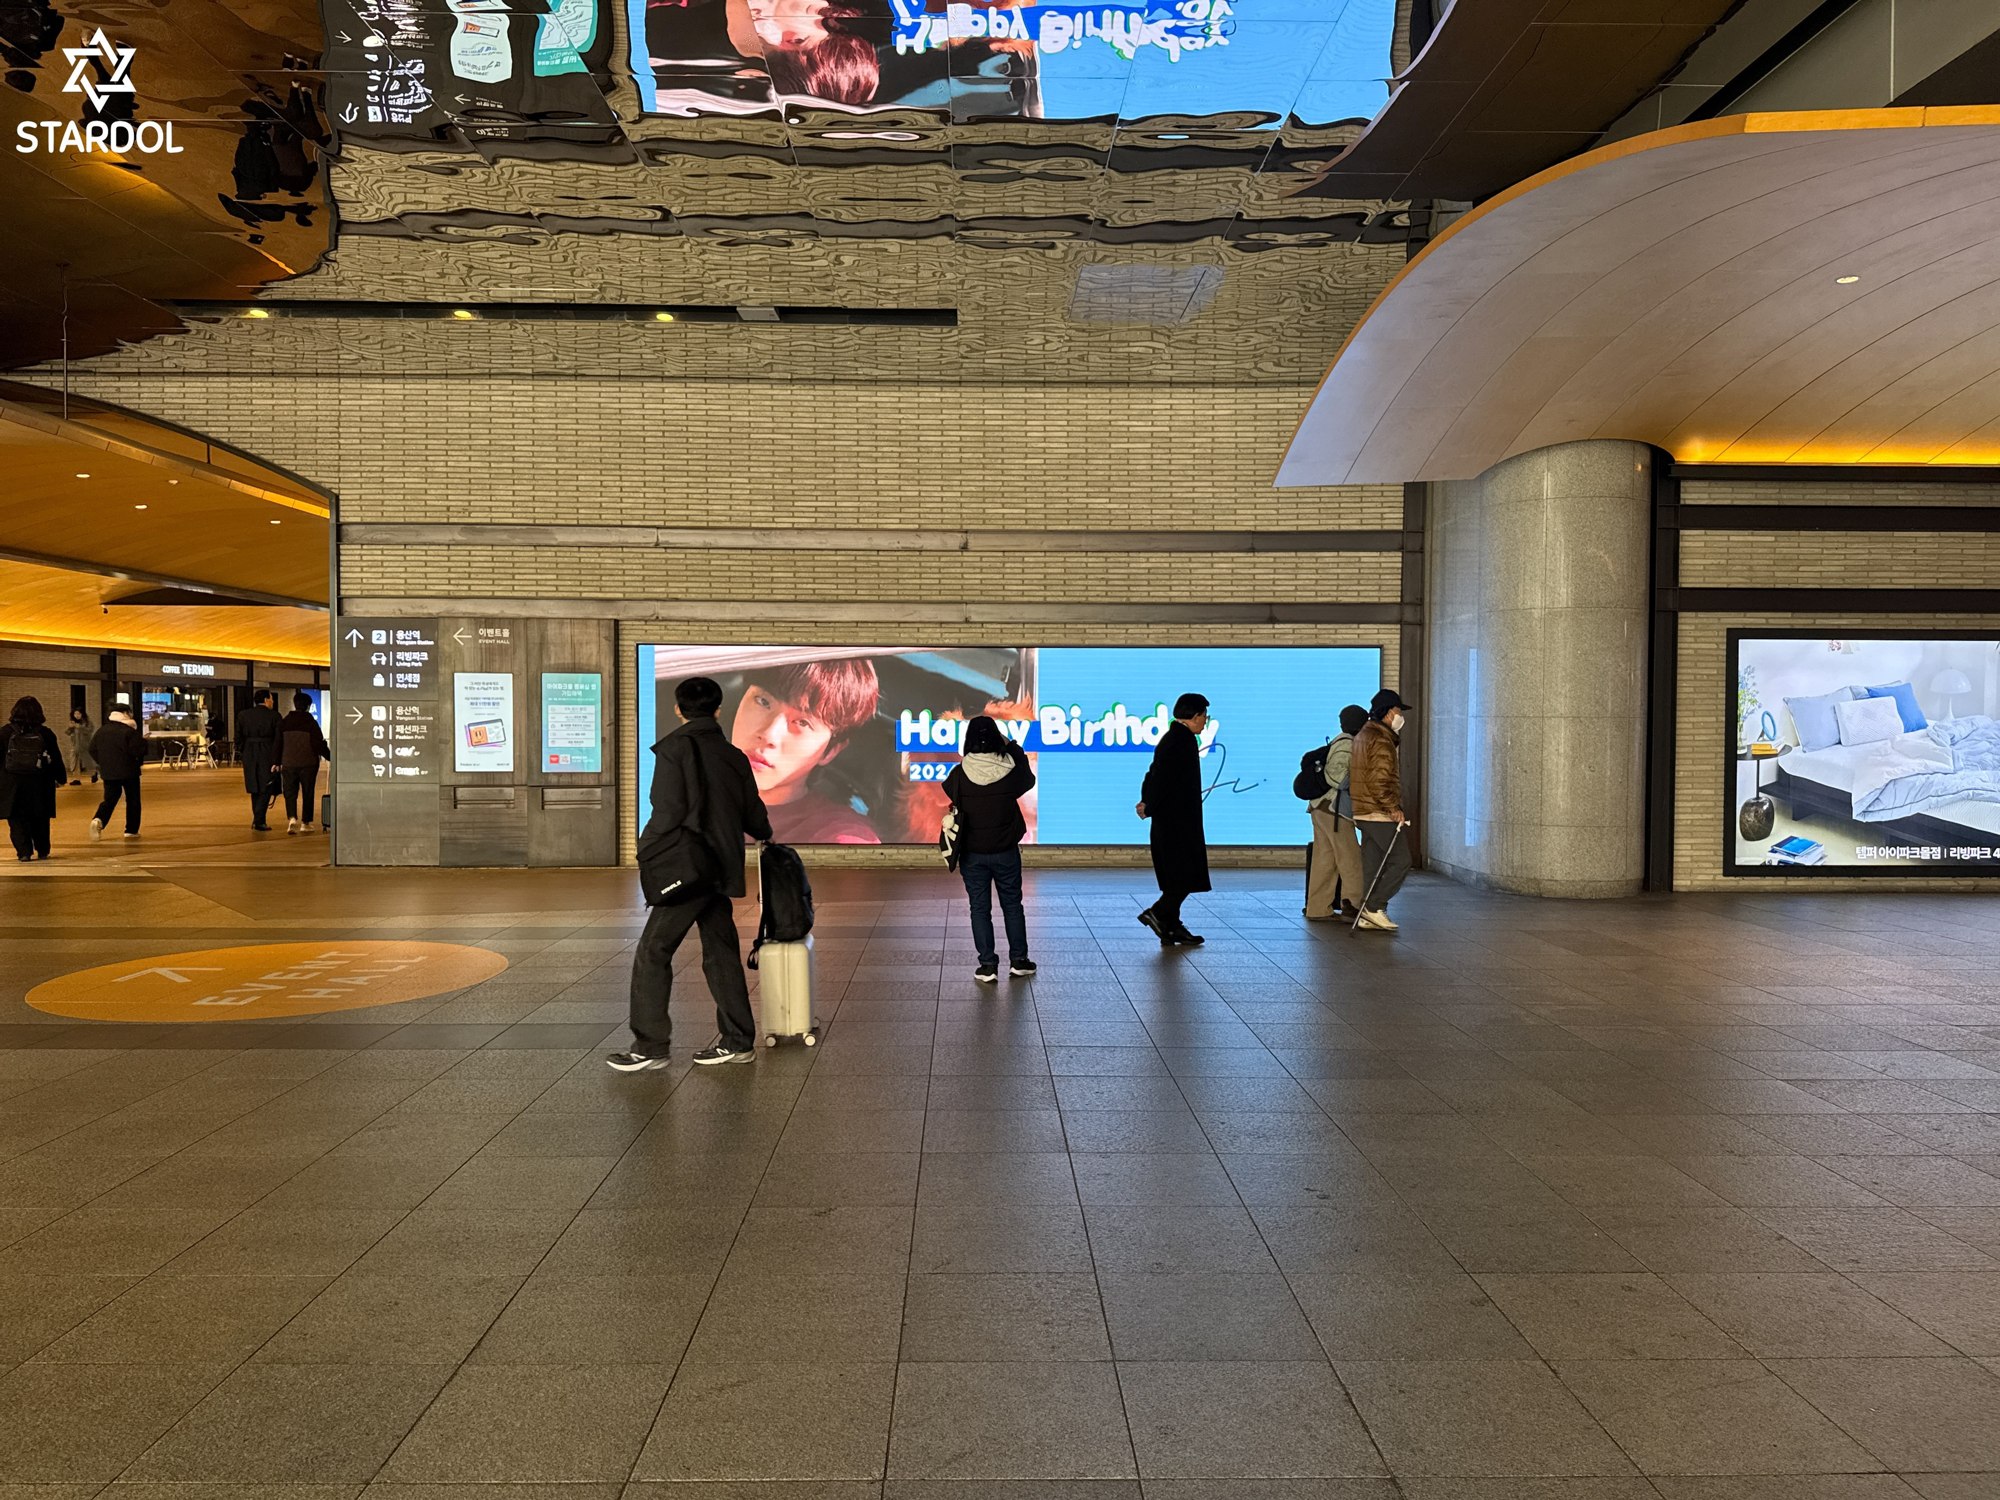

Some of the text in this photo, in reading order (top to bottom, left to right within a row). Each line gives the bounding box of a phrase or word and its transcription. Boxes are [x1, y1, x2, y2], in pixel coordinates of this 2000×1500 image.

[396, 630, 421, 640] 용산역
[478, 628, 510, 638] 이벤트홀
[396, 652, 429, 661] 리빙파크
[396, 673, 420, 683] 면세점
[396, 706, 420, 716] 용산역
[395, 725, 428, 734] 패션파크
[901, 701, 1220, 758] Hay Birthdy
[1855, 846, 1877, 860] 템퍼
[1878, 846, 1941, 860] 아이파크몰점
[1949, 846, 1992, 860] 리빙파크
[192, 950, 369, 1006] EVENT
[286, 955, 429, 999] HALL
